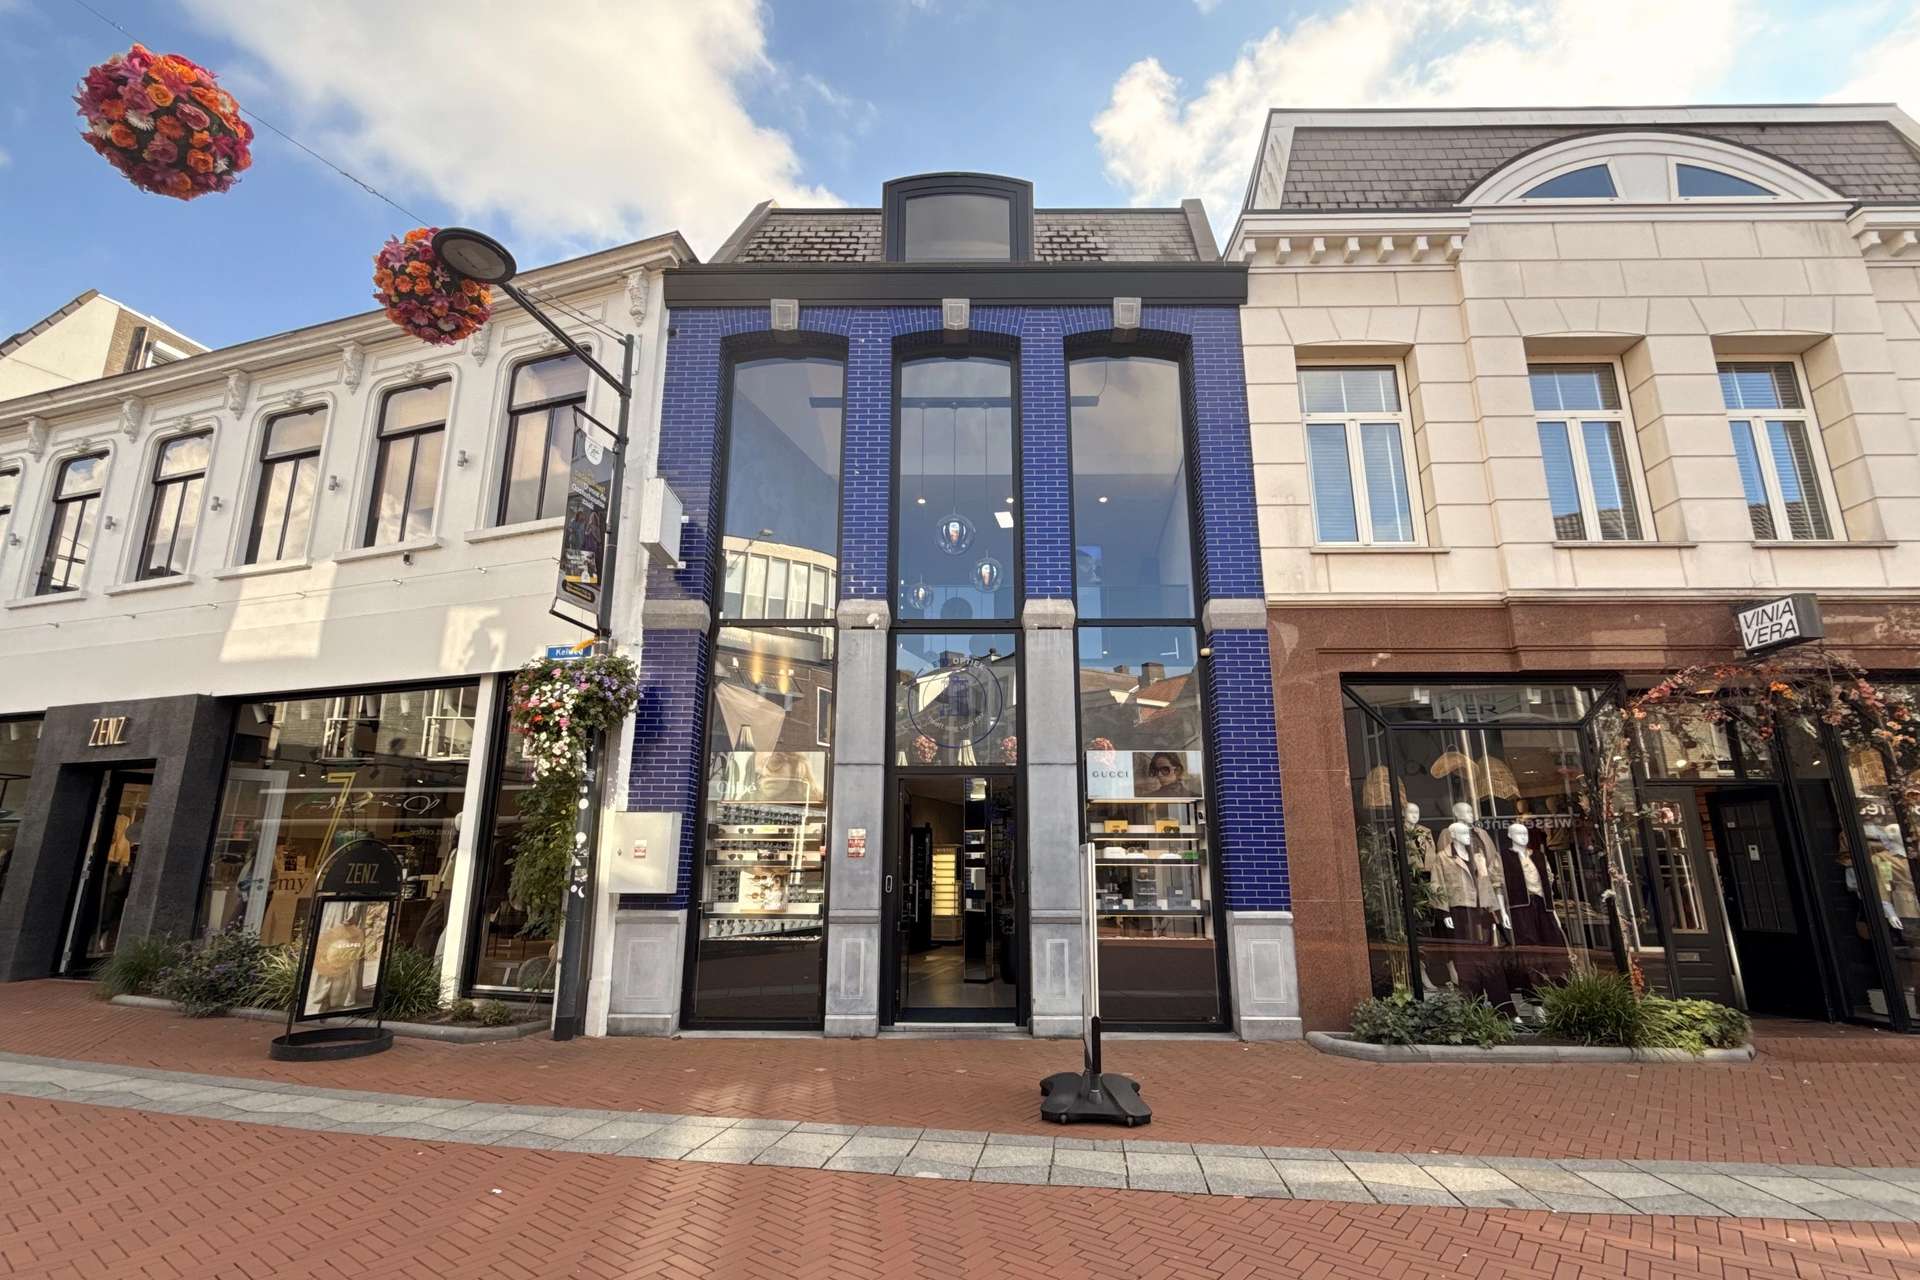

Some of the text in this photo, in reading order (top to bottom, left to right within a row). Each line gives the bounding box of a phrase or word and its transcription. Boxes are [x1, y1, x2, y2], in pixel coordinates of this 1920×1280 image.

[1743, 600, 1793, 629] VINIA
[1745, 619, 1797, 646] VERA
[88, 716, 127, 747] ZENZ
[1092, 770, 1129, 778] GUCCI
[345, 863, 380, 884] ZENZ
